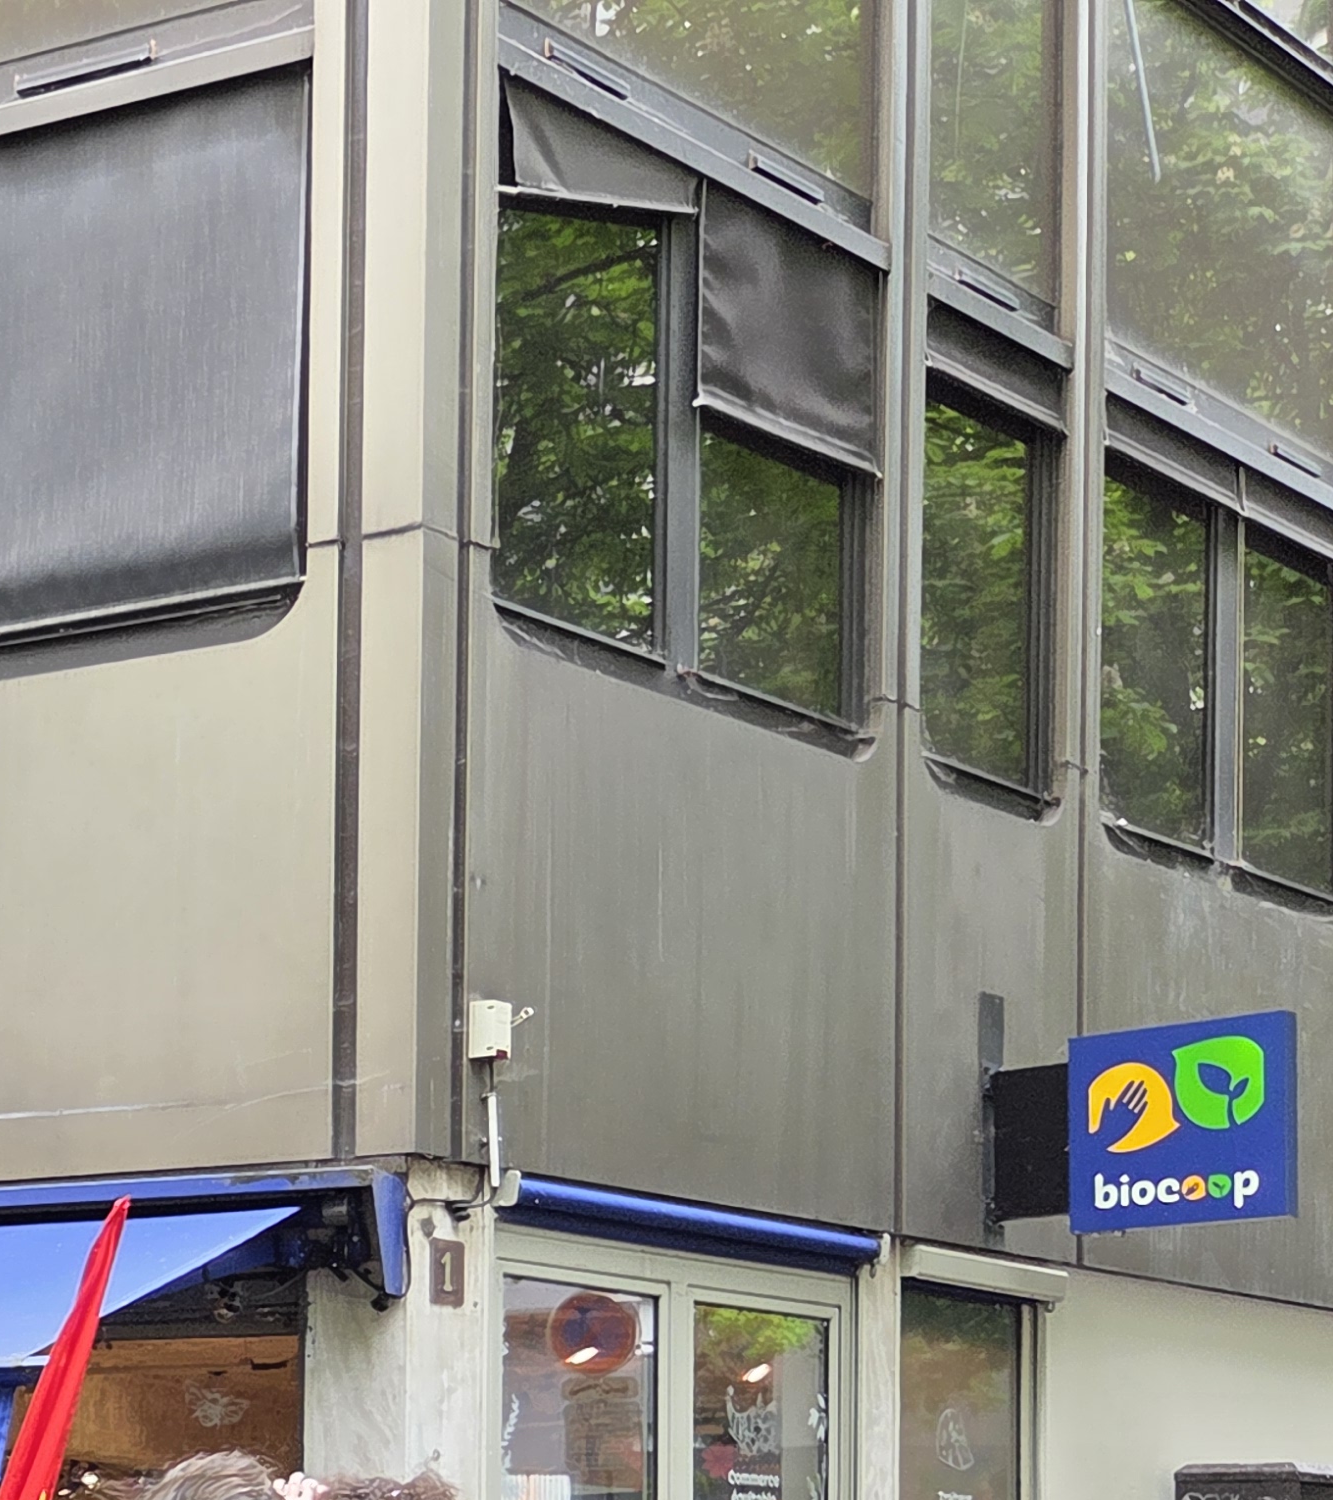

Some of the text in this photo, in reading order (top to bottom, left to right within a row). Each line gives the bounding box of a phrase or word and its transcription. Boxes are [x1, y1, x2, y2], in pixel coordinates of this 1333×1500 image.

[1094, 1169, 1260, 1209] biocoop
[441, 1251, 453, 1292] 1
[728, 1470, 779, 1488] Commerce
